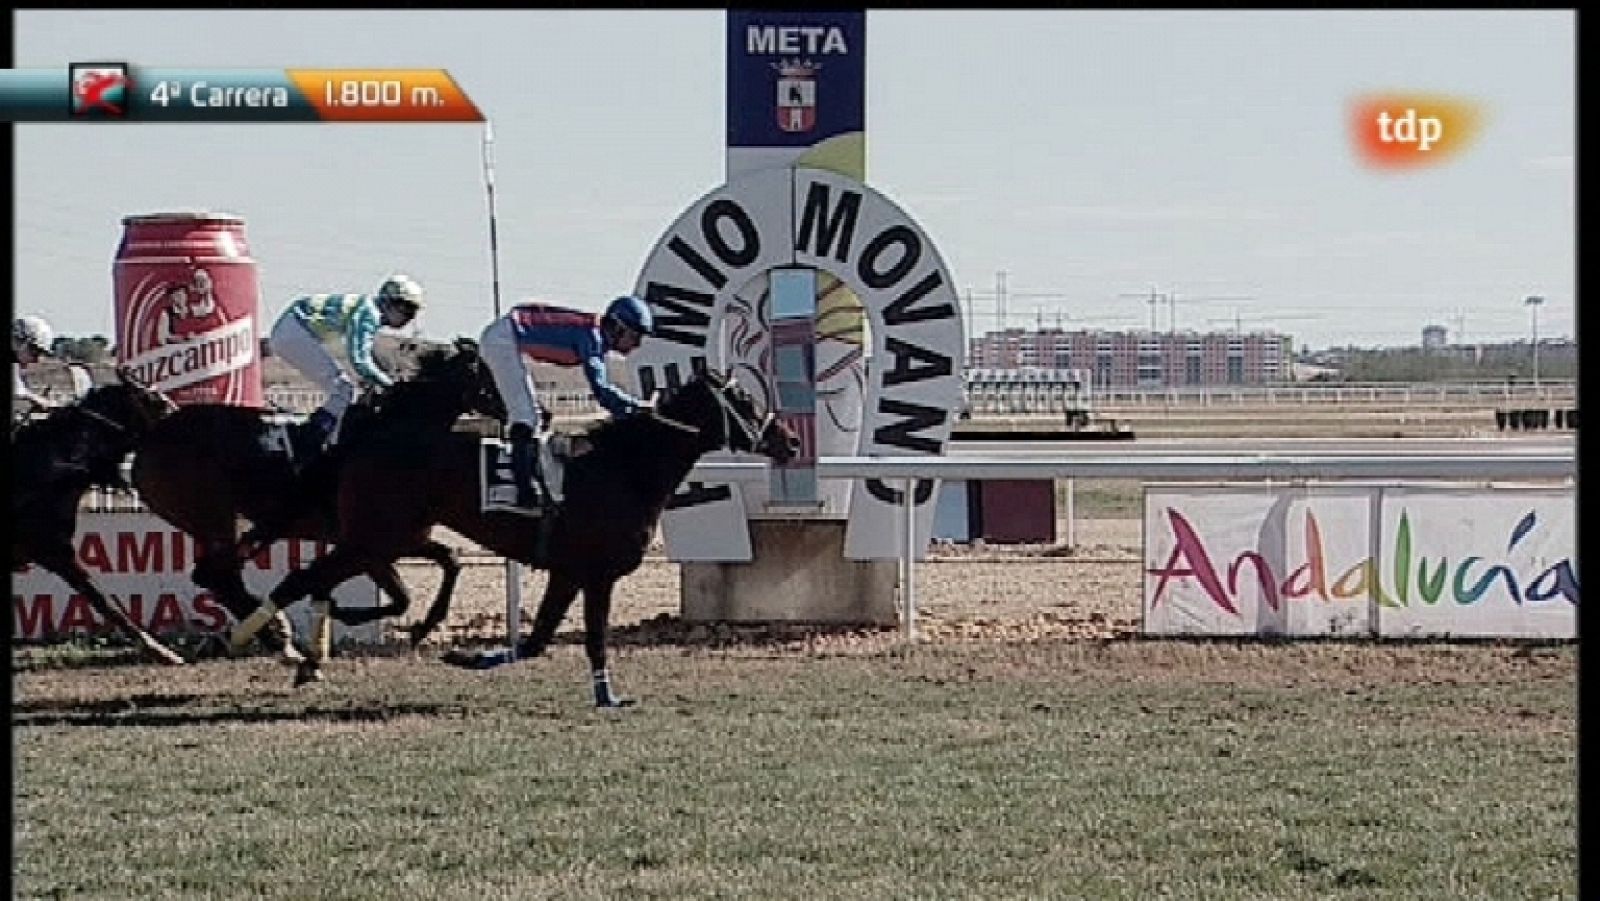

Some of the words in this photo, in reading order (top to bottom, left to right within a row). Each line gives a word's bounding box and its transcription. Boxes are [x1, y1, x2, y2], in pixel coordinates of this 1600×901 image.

[746, 25, 848, 55] META
[637, 199, 760, 509] EMIO
[1145, 507, 1579, 616] Andalucía
